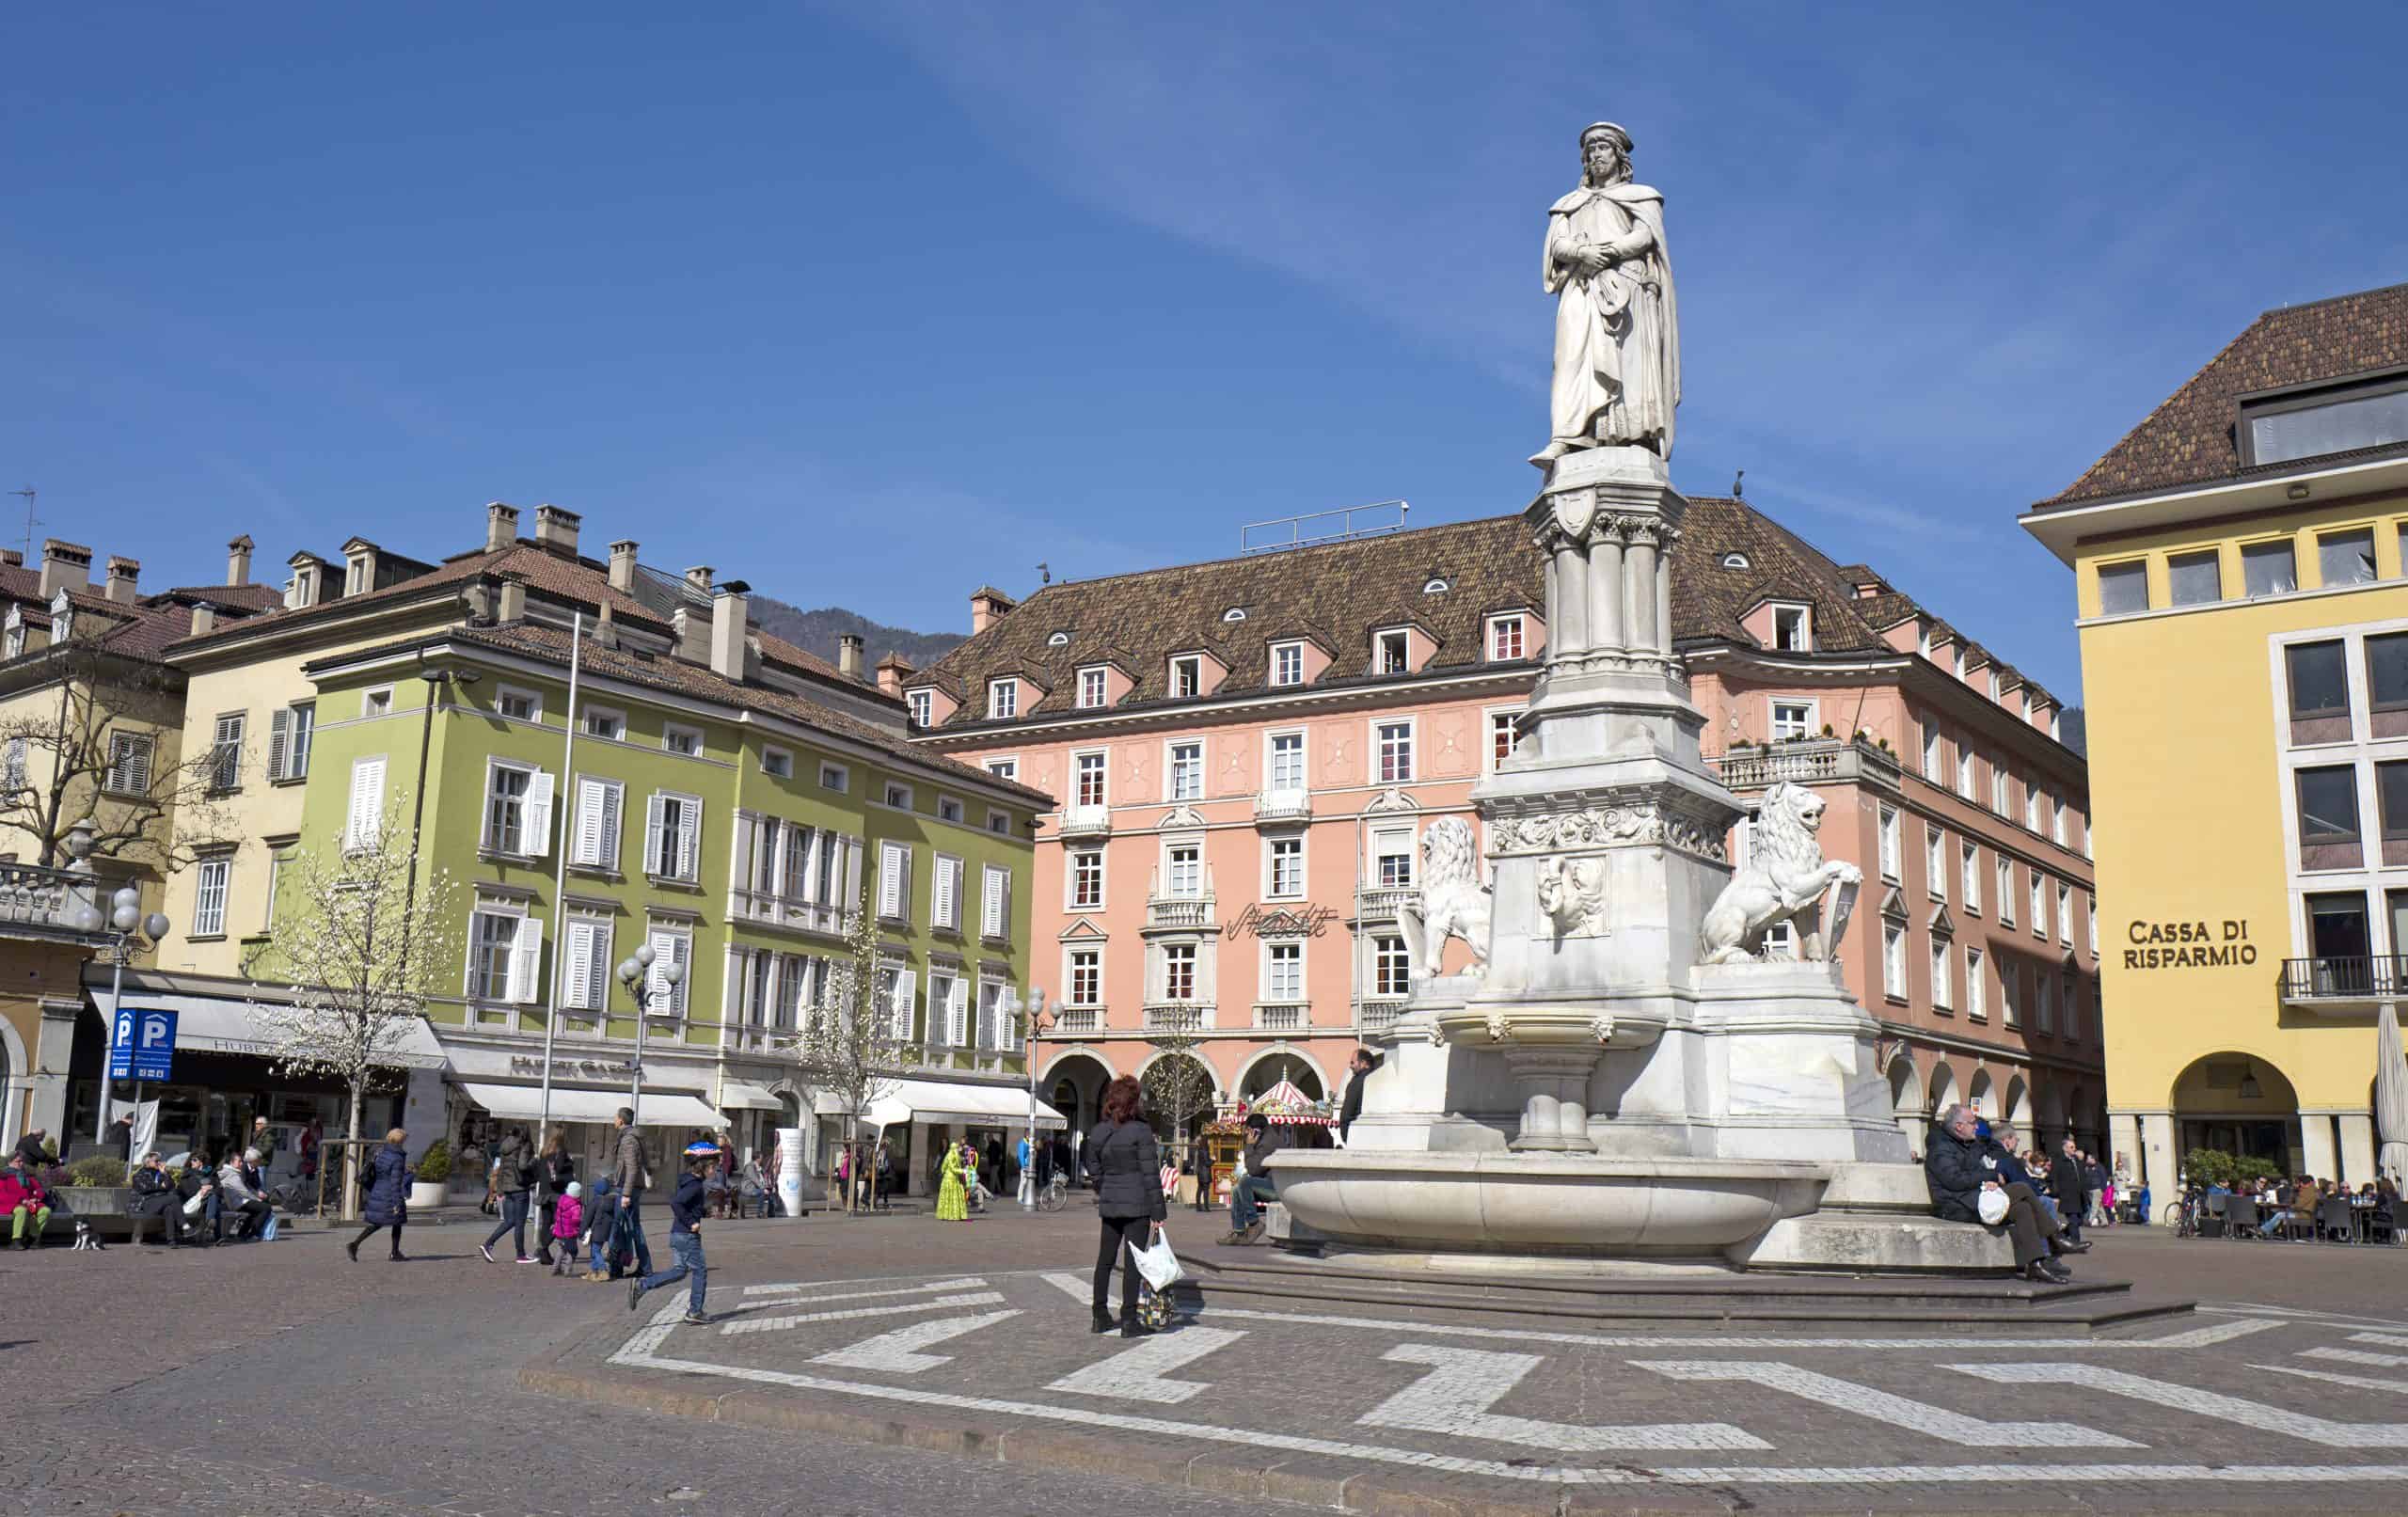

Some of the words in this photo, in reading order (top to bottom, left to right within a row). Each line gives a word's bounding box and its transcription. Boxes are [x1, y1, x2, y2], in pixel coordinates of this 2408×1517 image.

[2129, 920, 2210, 944] CASSA
[2223, 920, 2248, 940] DI
[2124, 944, 2257, 969] RISPARMIO
[117, 1019, 131, 1047] P
[142, 1020, 166, 1048] P
